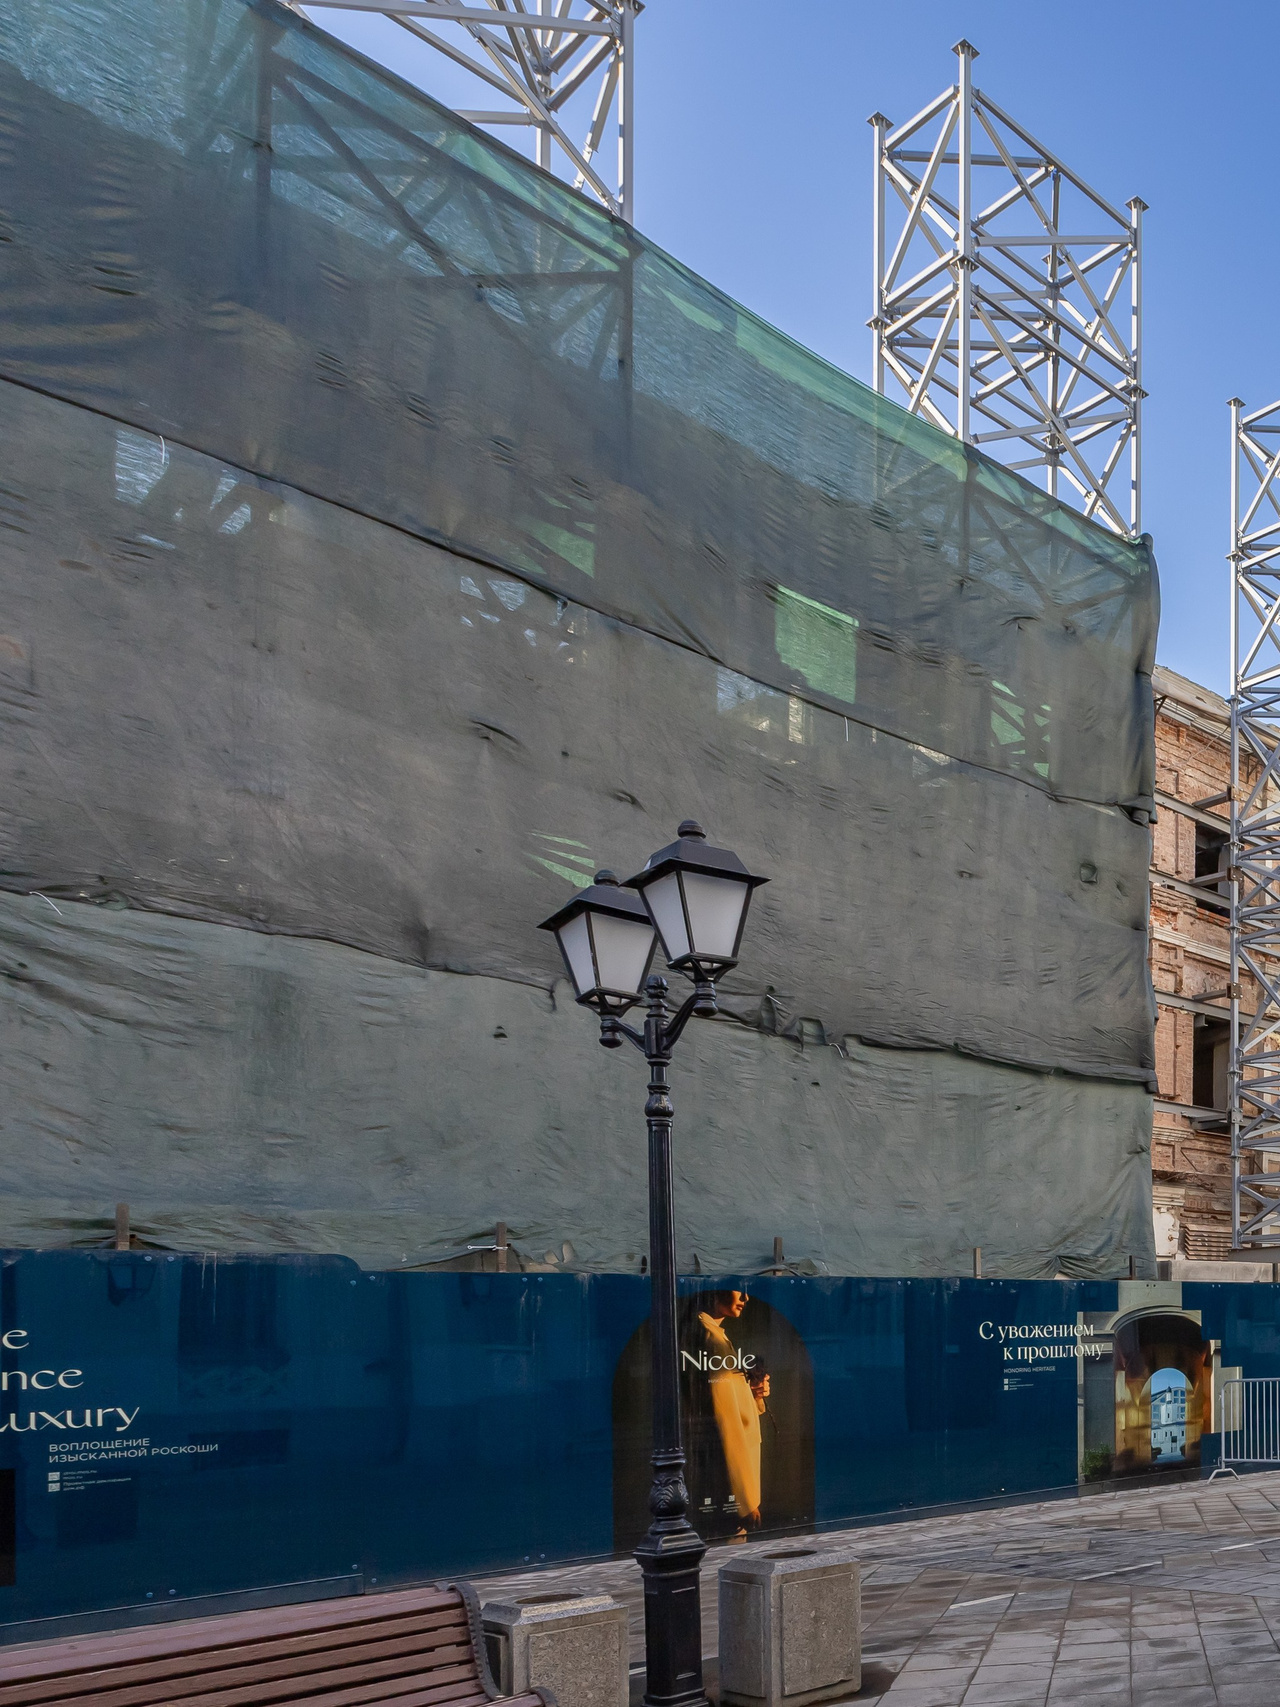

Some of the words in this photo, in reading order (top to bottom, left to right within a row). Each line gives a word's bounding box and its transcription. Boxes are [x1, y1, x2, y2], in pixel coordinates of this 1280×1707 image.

[979, 1321, 994, 1340] С
[998, 1324, 1094, 1343] уважением
[680, 1348, 757, 1372] Nicole
[1003, 1347, 1014, 1360] к
[1017, 1344, 1104, 1364] прошлому
[49, 1438, 151, 1453] ВОПЛОЩЕНИЕ
[49, 1448, 148, 1463] ИЗЫСКАННОЙ
[151, 1443, 219, 1456] РОСКОШИ
